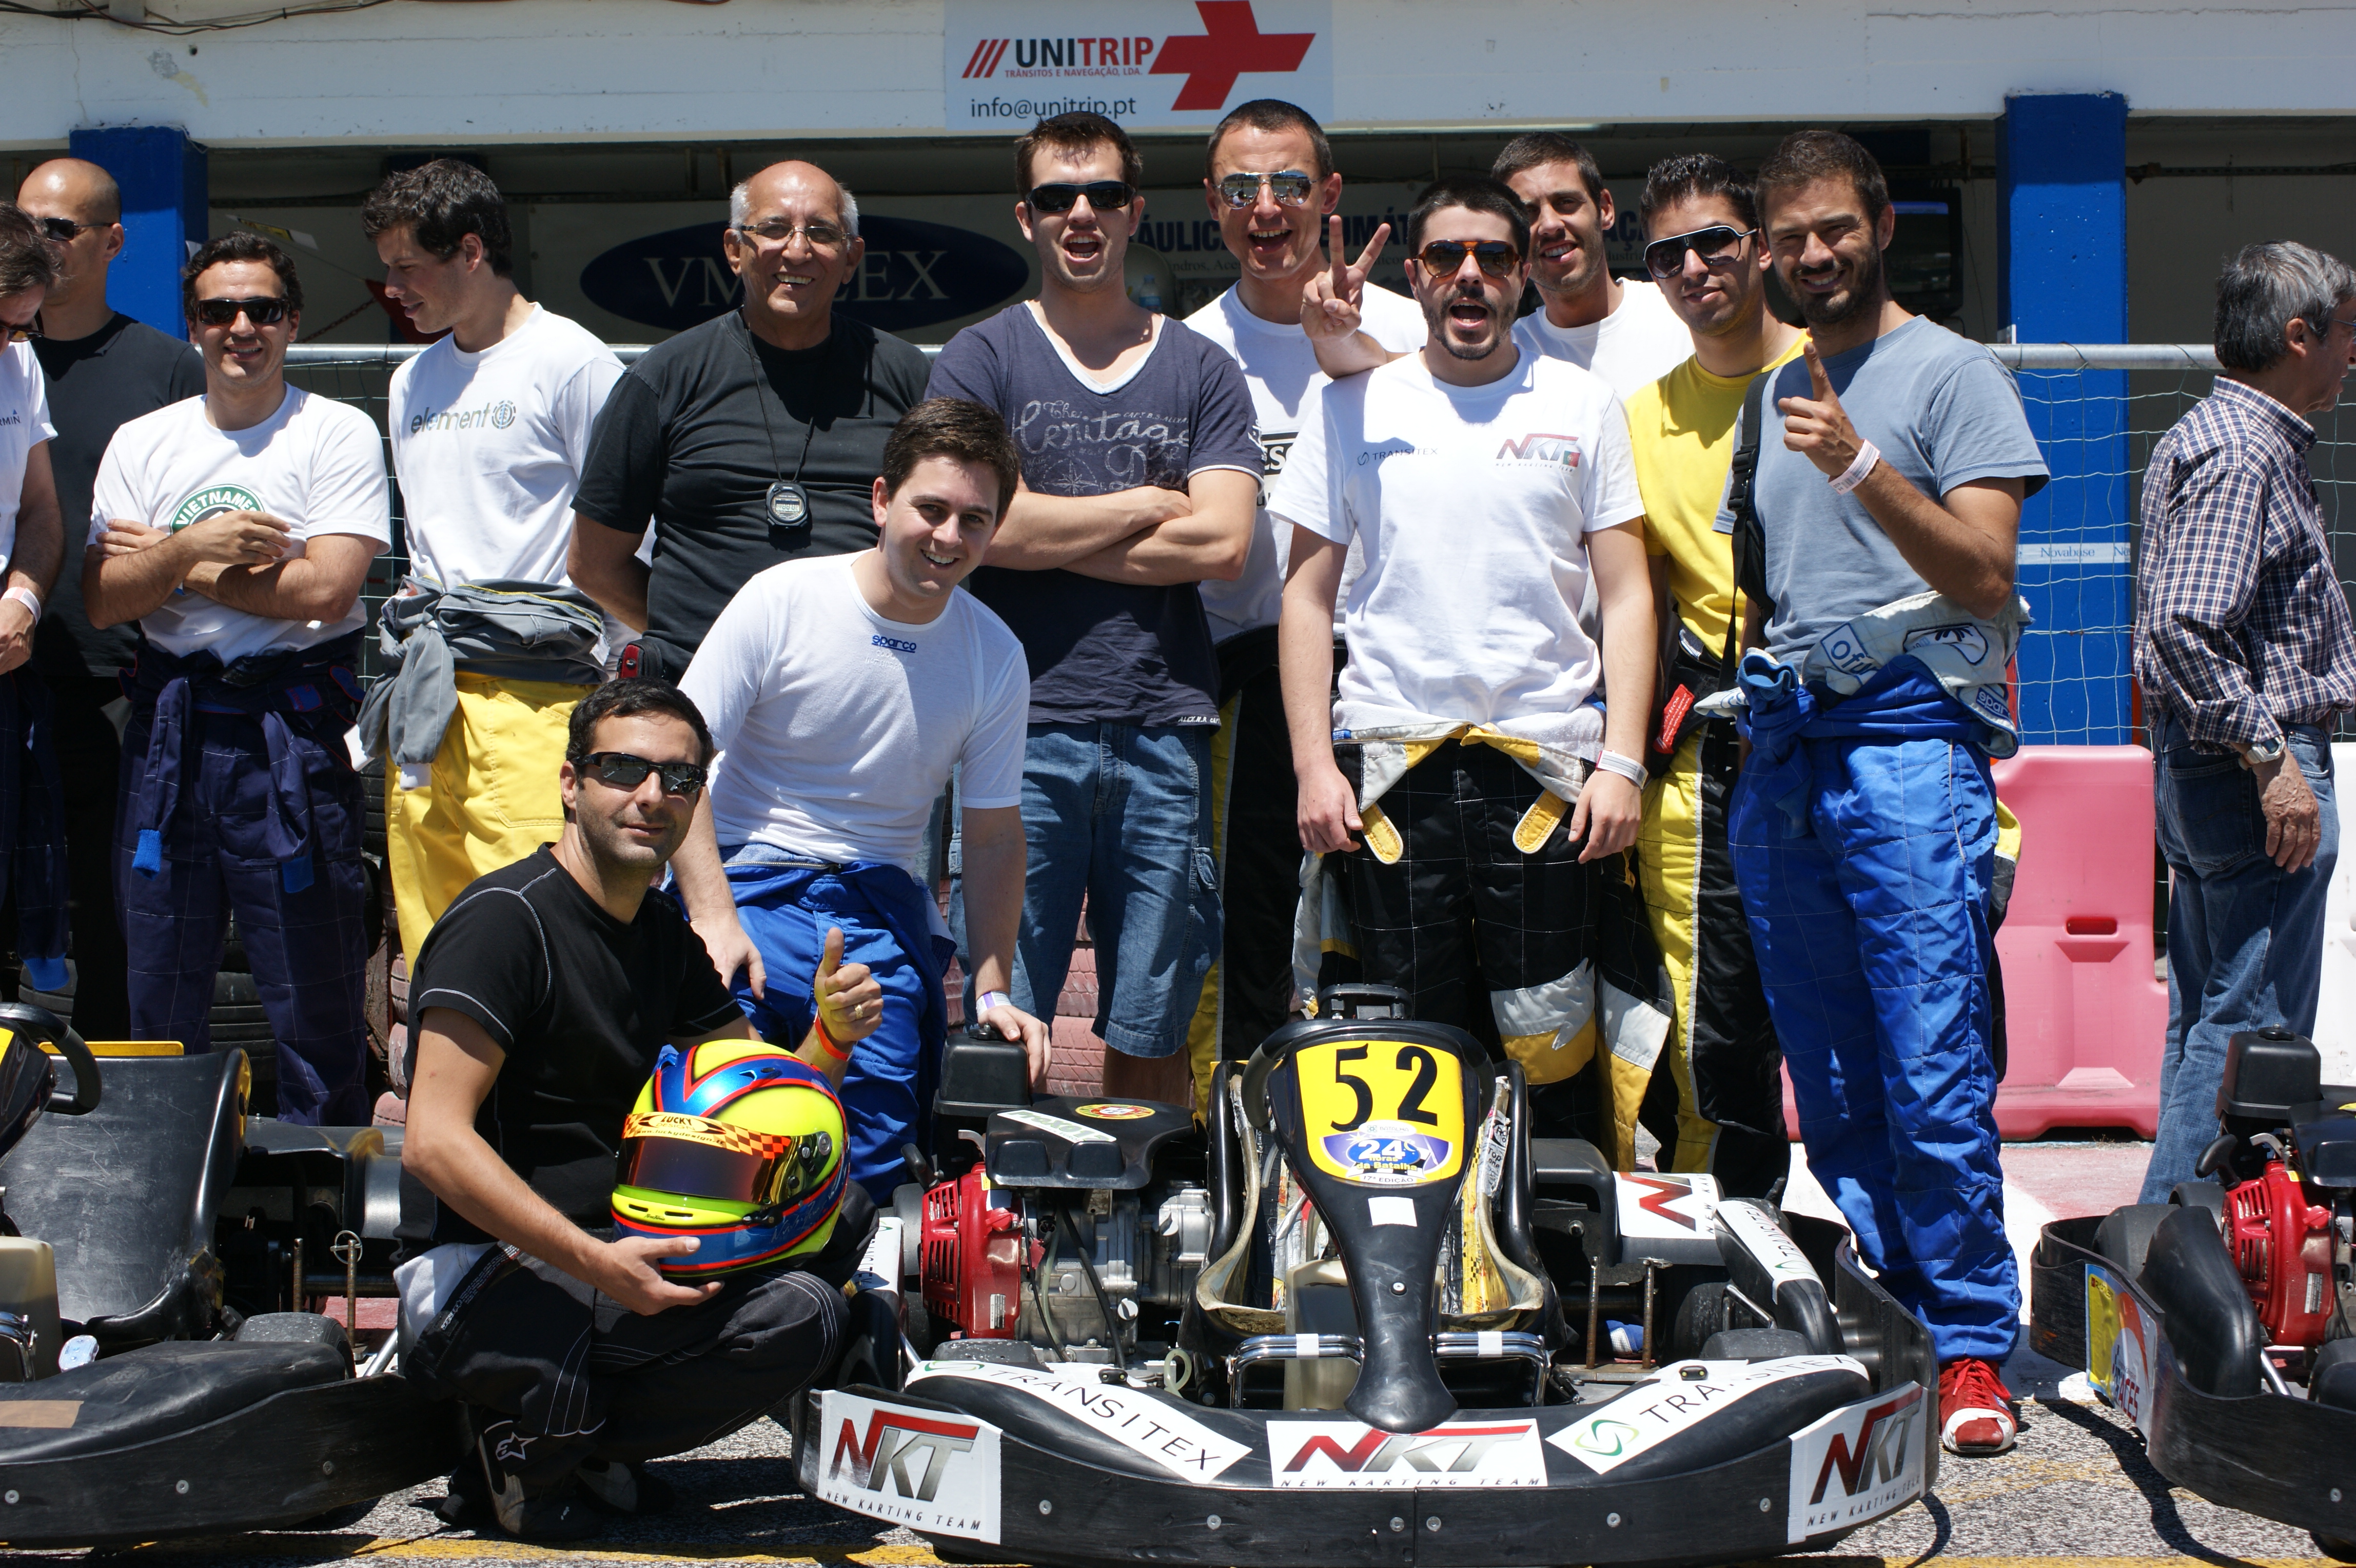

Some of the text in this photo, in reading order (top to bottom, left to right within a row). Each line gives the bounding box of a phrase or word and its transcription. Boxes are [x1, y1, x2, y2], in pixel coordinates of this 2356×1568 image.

[1015, 37, 1154, 68] UNITRIP
[1005, 68, 1053, 77] TRÂNSITOS
[971, 96, 1136, 119] info@unitrip.pt
[411, 402, 491, 434] element
[1373, 448, 1438, 460] TRANSITEX
[2040, 546, 2095, 557] Novabase
[872, 635, 917, 652] sparco
[656, 1123, 696, 1131] DESIGN
[660, 1115, 692, 1126] LUCKY
[1358, 1140, 1405, 1160] 24
[1373, 1162, 1417, 1171] Batalha
[995, 1369, 1223, 1471] TRANSITEX
[828, 1408, 980, 1502] NKT
[1282, 1425, 1532, 1472] NKT
[1349, 1478, 1458, 1486] KARTING
[1480, 1478, 1540, 1486] TEAM
[826, 1490, 981, 1531] NEW KARTING TEAM
[1807, 1510, 1838, 1526] NEW
[1849, 1488, 1896, 1517] KARTING
